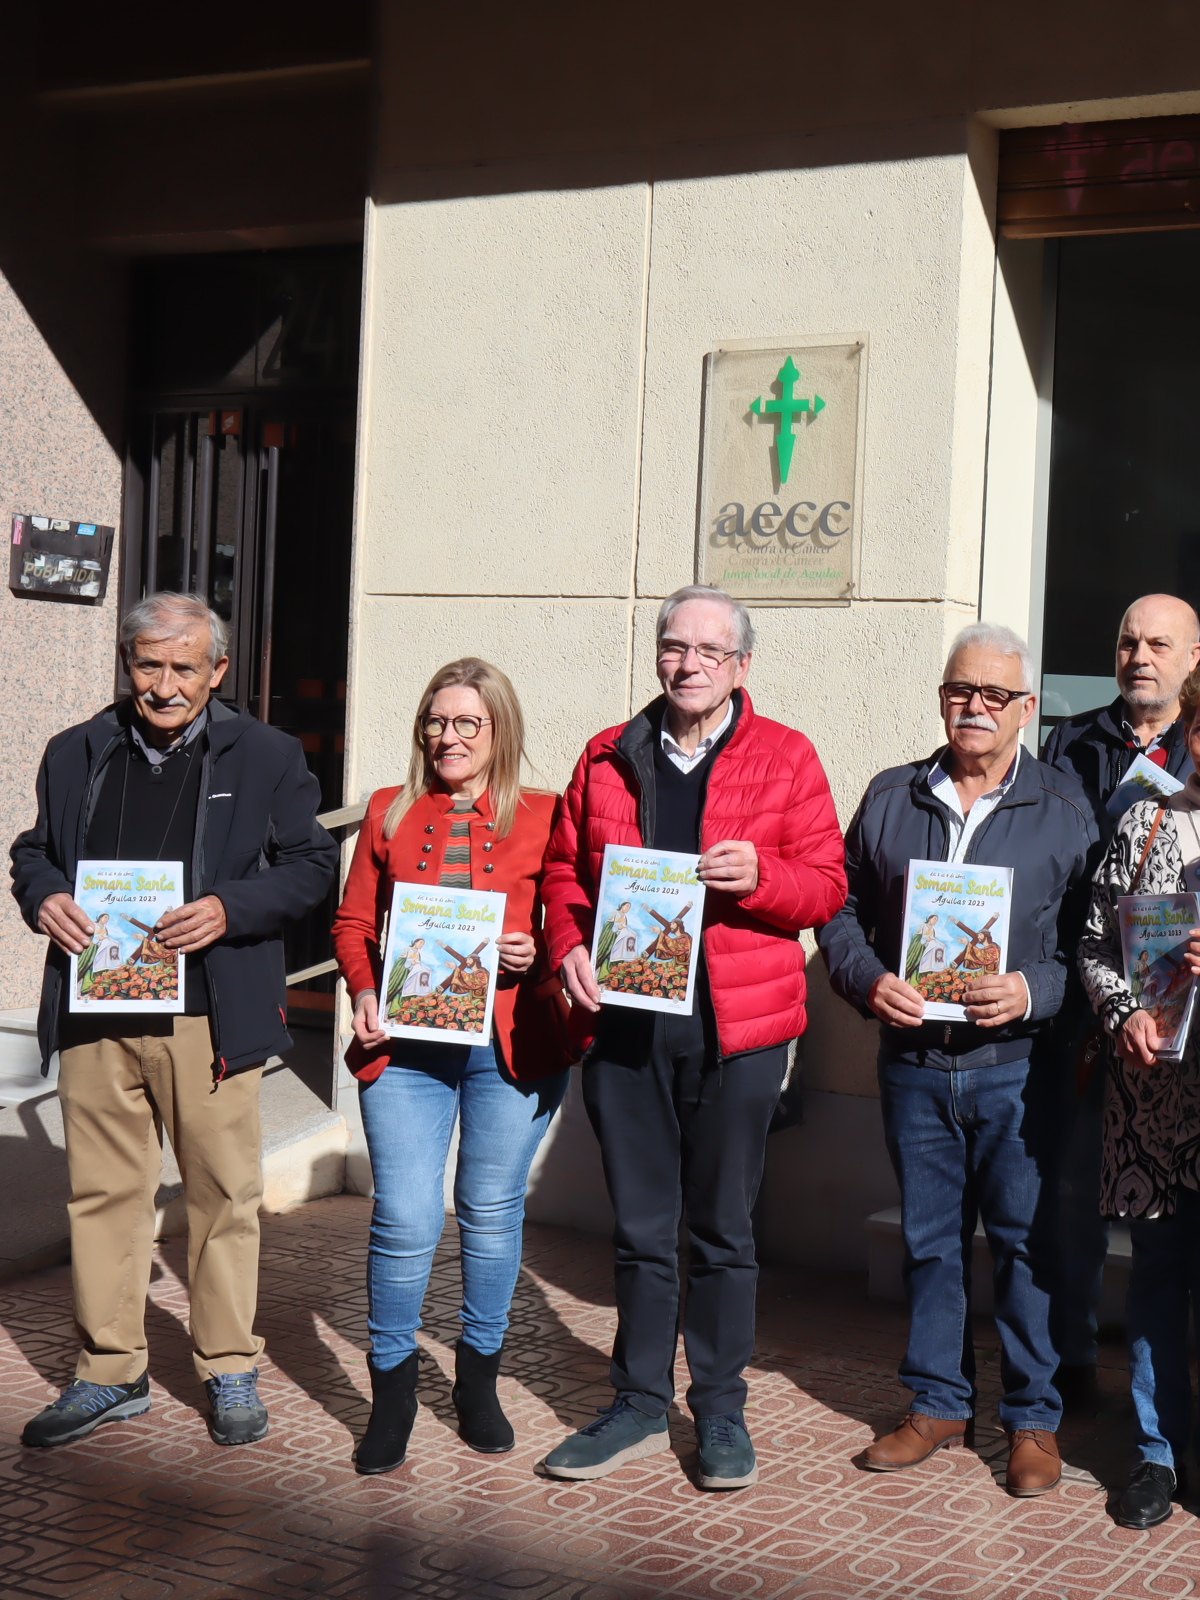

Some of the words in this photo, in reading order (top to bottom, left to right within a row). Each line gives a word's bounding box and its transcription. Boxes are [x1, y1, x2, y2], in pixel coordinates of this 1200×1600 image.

[717, 501, 850, 537] aecc
[736, 542, 777, 554] Contra
[779, 542, 788, 553] el
[792, 542, 831, 554] Cáncer
[721, 569, 751, 581] Junta
[754, 568, 781, 579] local
[784, 568, 796, 579] de
[800, 566, 843, 579] Águilas
[609, 860, 657, 880] Semana
[661, 866, 699, 885] Santa
[83, 875, 132, 890] Semana
[136, 874, 175, 891] Santa
[624, 880, 660, 893] Águilas
[662, 887, 679, 895] 2023
[915, 874, 962, 893] Semana
[966, 879, 1004, 897] Santa
[101, 892, 136, 904] Águilas
[931, 893, 966, 906] Águilas
[401, 898, 452, 918] Semana
[456, 904, 496, 923] Santa
[1125, 911, 1161, 927] Semana
[1164, 905, 1194, 925] Santa
[418, 917, 455, 930] Águilas
[1139, 927, 1166, 940] Águilas
